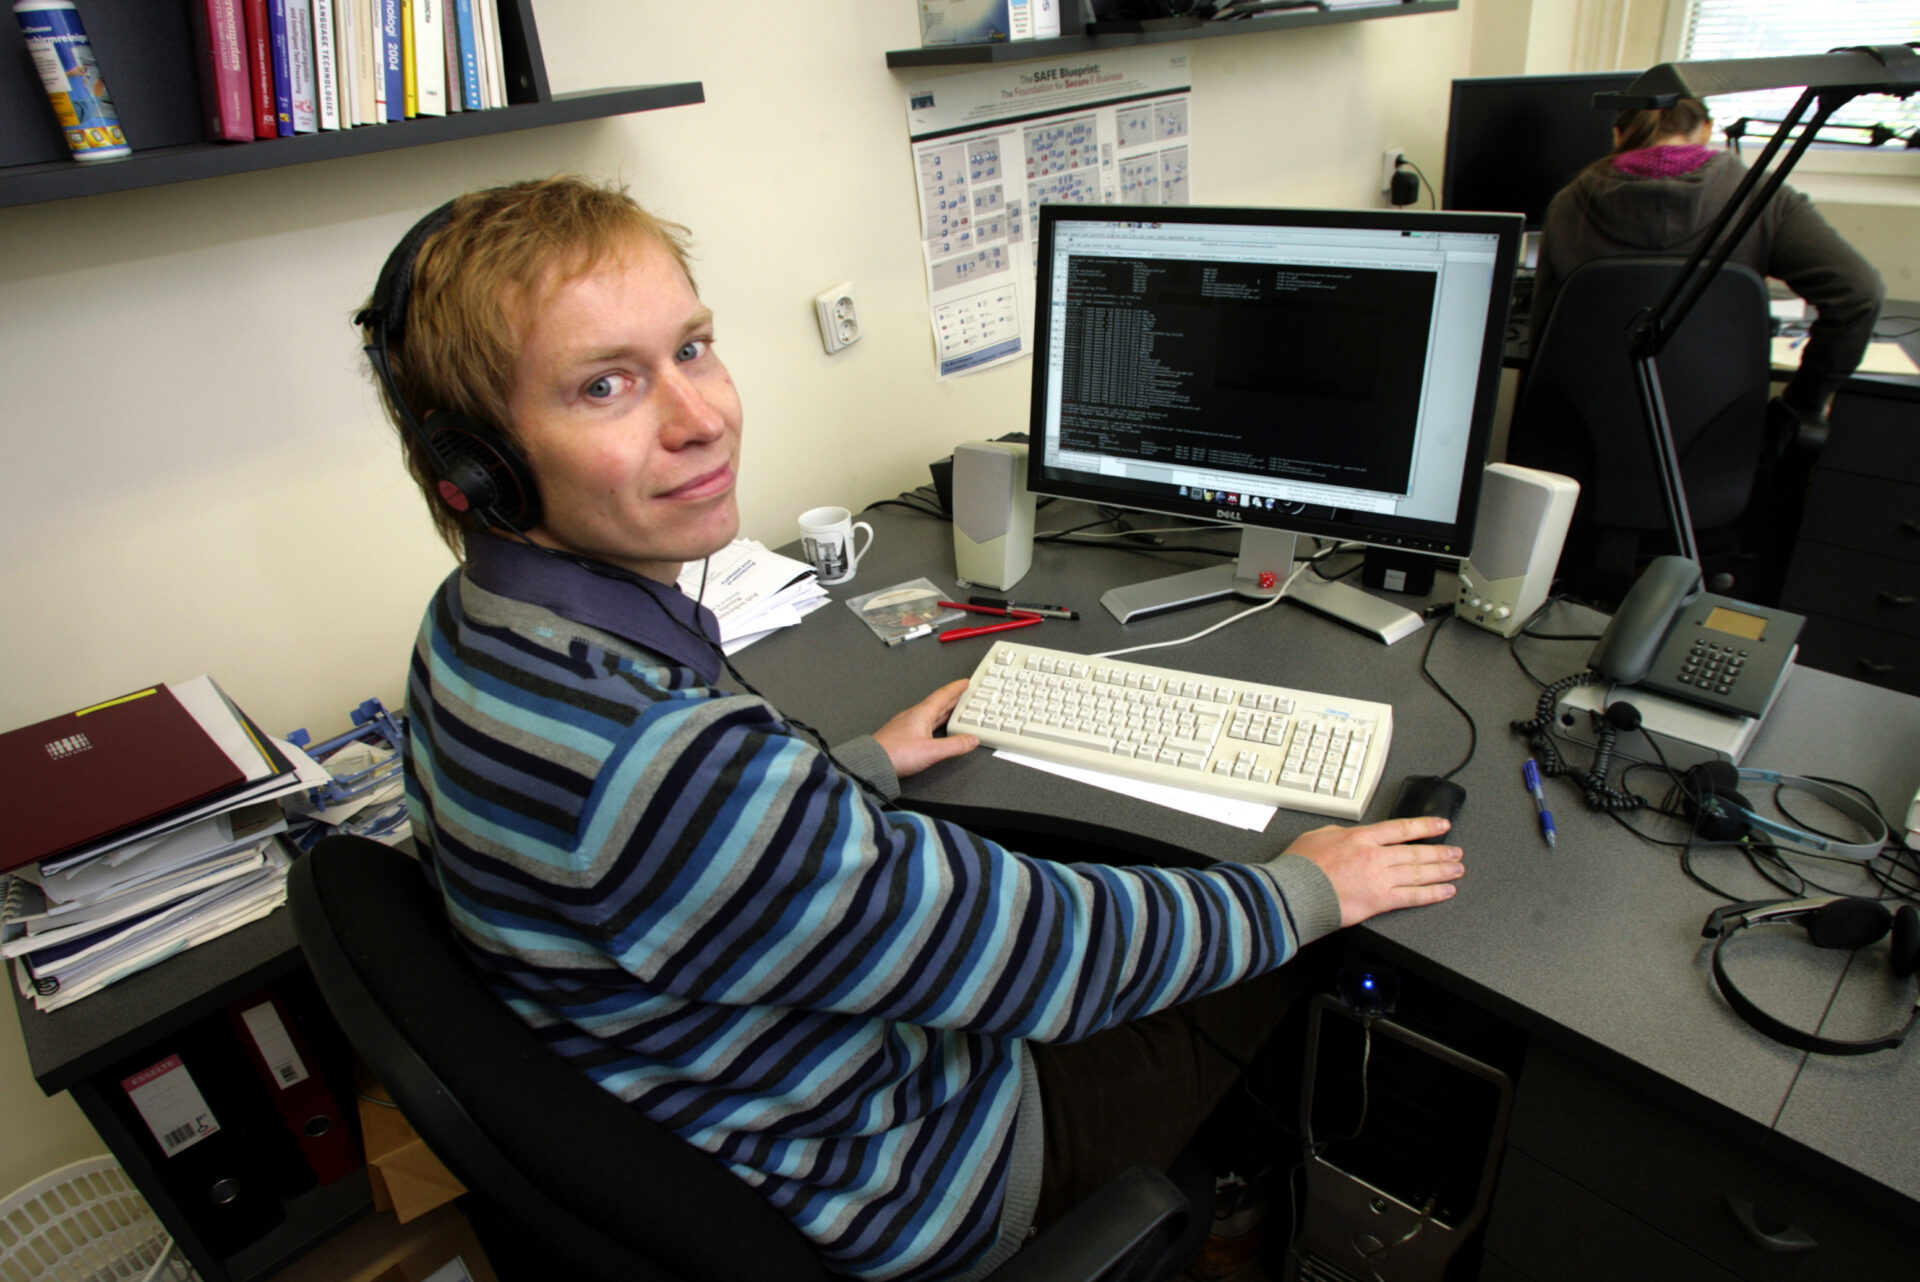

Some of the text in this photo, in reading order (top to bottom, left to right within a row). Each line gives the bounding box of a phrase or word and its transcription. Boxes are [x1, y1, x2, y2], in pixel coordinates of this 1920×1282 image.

[291, 20, 300, 50] Intelligent
[299, 8, 310, 83] Computational Linguistics
[387, 43, 400, 71] 2004
[323, 50, 334, 117] TECHNOLOGIES
[1020, 64, 1101, 85] The SAFE Blueprint:
[1000, 89, 1014, 100] The
[1014, 83, 1054, 98] Foundation
[1055, 81, 1065, 91] for
[1064, 78, 1090, 90] Secure
[1216, 509, 1242, 521] DELL
[132, 1061, 174, 1085] ESSELTE
